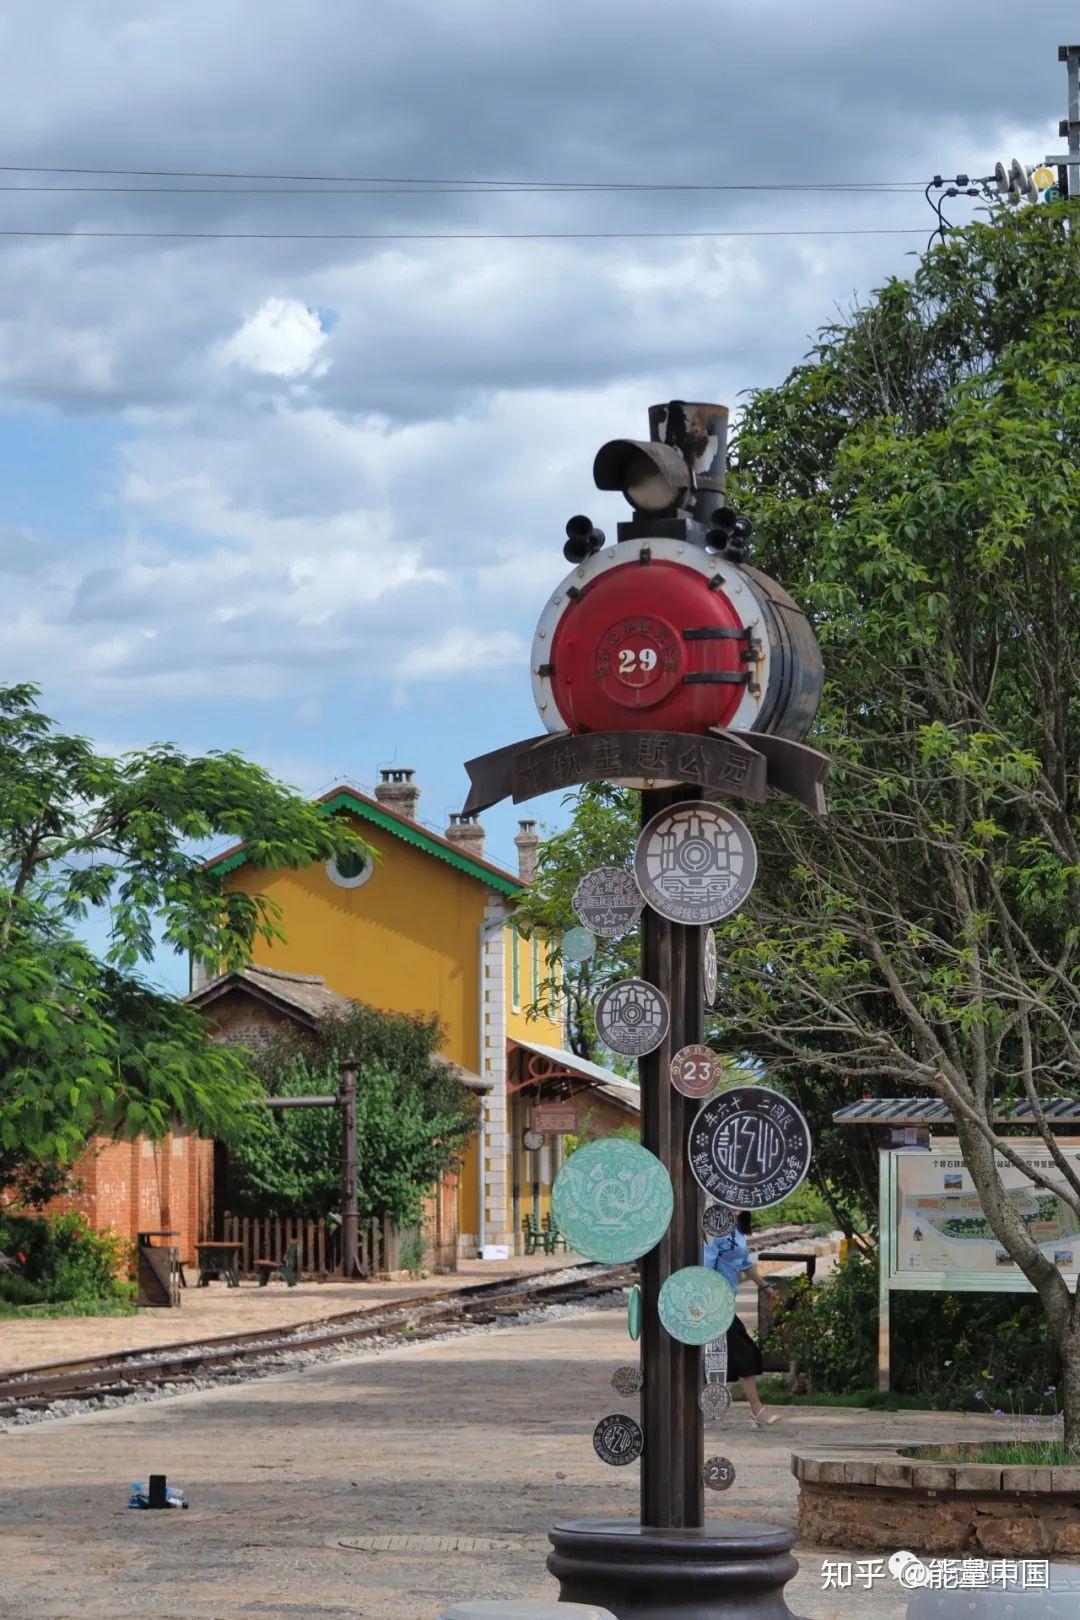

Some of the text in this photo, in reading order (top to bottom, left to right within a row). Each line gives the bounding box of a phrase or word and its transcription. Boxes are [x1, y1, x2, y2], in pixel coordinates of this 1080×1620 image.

[618, 648, 657, 674] 29
[518, 737, 754, 788] 寸轨主题公园
[683, 1061, 711, 1081] 23
[710, 1466, 728, 1481] 23
